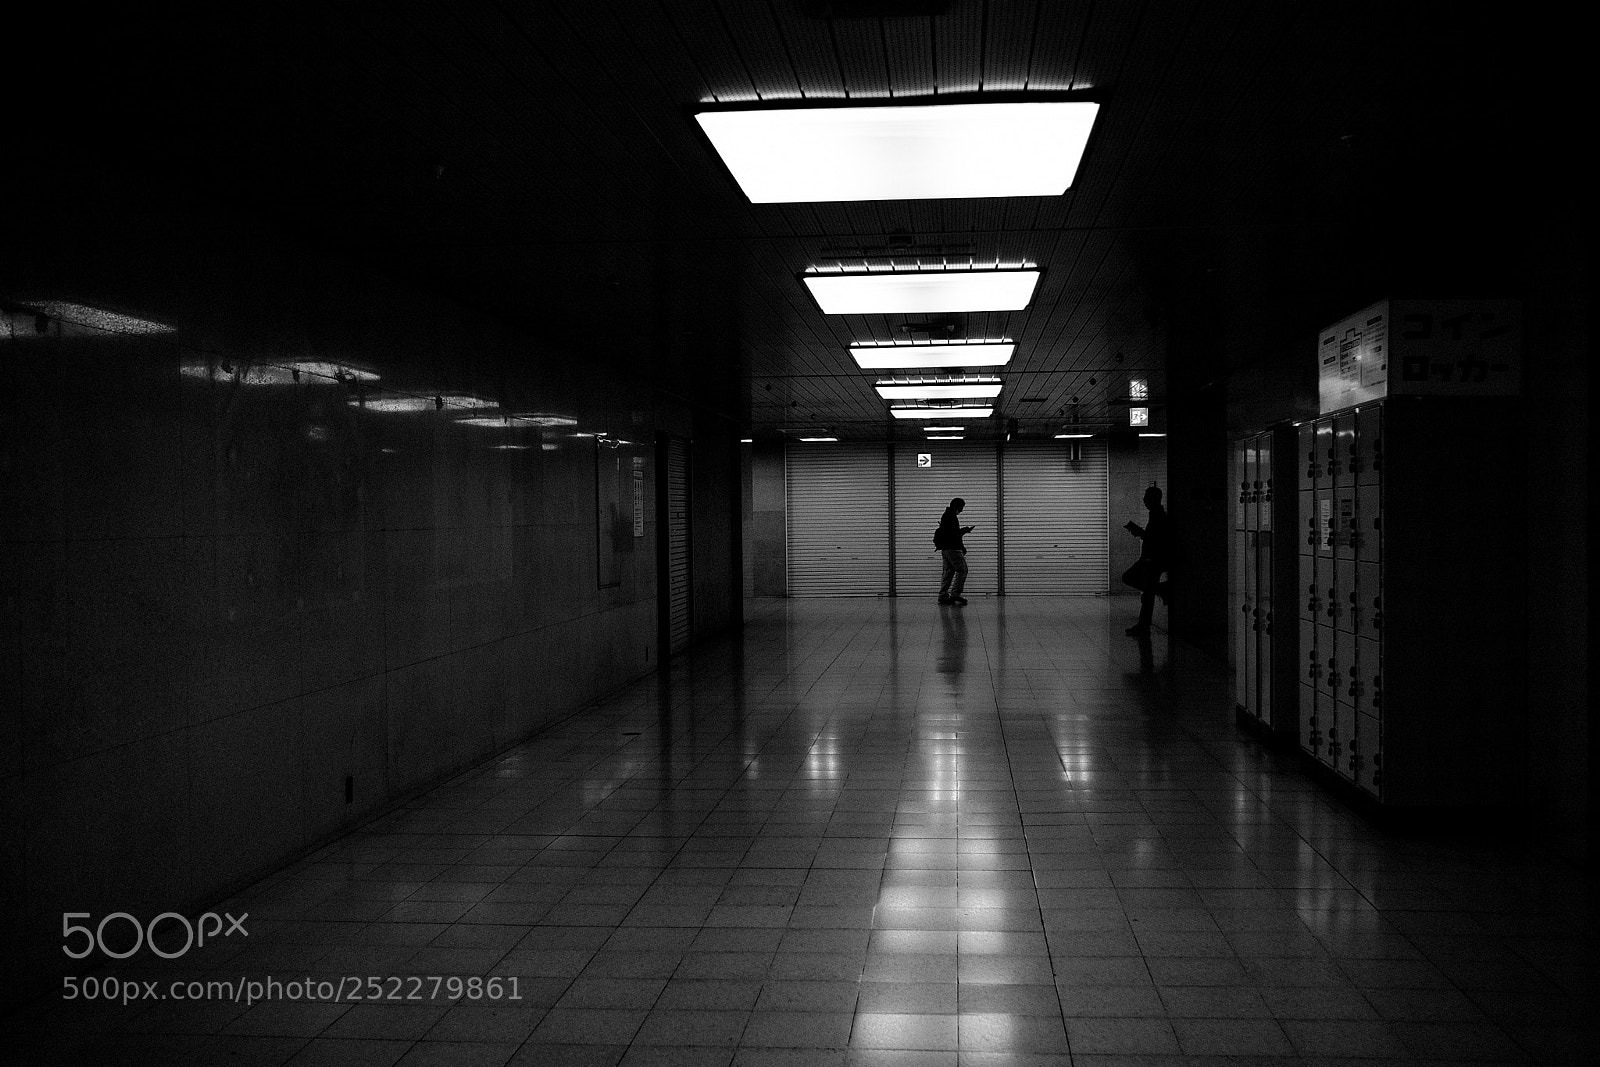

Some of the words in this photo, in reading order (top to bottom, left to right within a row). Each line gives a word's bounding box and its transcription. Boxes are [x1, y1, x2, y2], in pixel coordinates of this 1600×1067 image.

[1403, 313, 1511, 340] コイン
[1403, 355, 1509, 382] ロッカー
